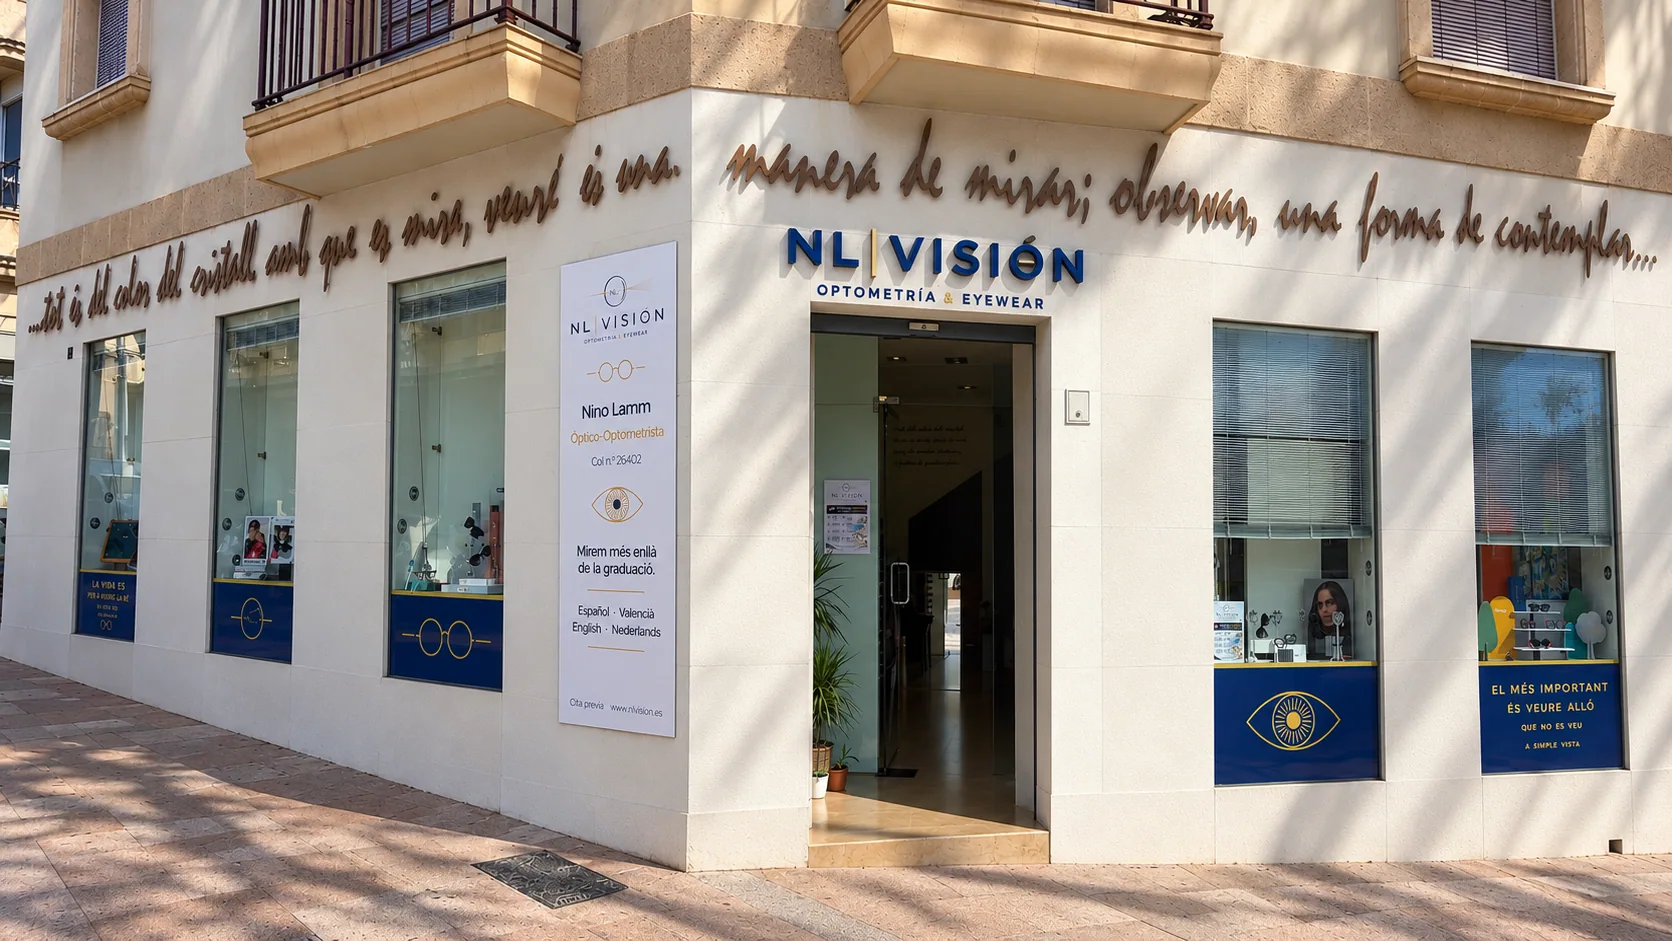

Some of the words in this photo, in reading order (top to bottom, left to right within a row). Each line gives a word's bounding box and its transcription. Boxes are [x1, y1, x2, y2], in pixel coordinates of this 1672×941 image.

[726, 143, 881, 200] manera
[900, 118, 944, 198] de
[1278, 199, 1342, 234] una
[1359, 171, 1445, 263] forma
[1457, 183, 1484, 244] de
[88, 263, 109, 319] del
[157, 241, 185, 302] del
[265, 204, 311, 276] amb
[319, 225, 357, 292] que
[889, 235, 1084, 285] VISIÓN
[817, 284, 936, 304] OPTOMETRÍA
[944, 292, 953, 304] &
[962, 293, 1045, 310] EYEWEAR
[601, 307, 665, 331] VISIÓN
[582, 405, 609, 420] Nino
[612, 402, 651, 416] Lamm
[570, 426, 665, 446] Óptico-Optometrista
[616, 454, 642, 466] 26402
[576, 545, 607, 558] Mirem
[609, 545, 631, 558] més
[633, 545, 657, 558] enllà
[578, 562, 591, 574] de
[593, 562, 601, 574] la
[603, 562, 655, 577] graduació.
[118, 582, 125, 591] ES
[578, 605, 610, 618] Español
[618, 607, 655, 620] Valencià
[572, 622, 602, 635] English
[611, 625, 661, 638] Nederlands
[1492, 685, 1505, 695] EL
[1510, 682, 1535, 695] MÉS
[1540, 682, 1608, 694] IMPORTANT
[569, 698, 583, 708] Cita
[1507, 703, 1520, 714] ÉS
[1526, 703, 1562, 713] VEURE
[1568, 699, 1594, 711] ALLÓ
[1521, 723, 1536, 732] QUE
[1541, 723, 1552, 731] NO
[1555, 722, 1565, 730] ES
